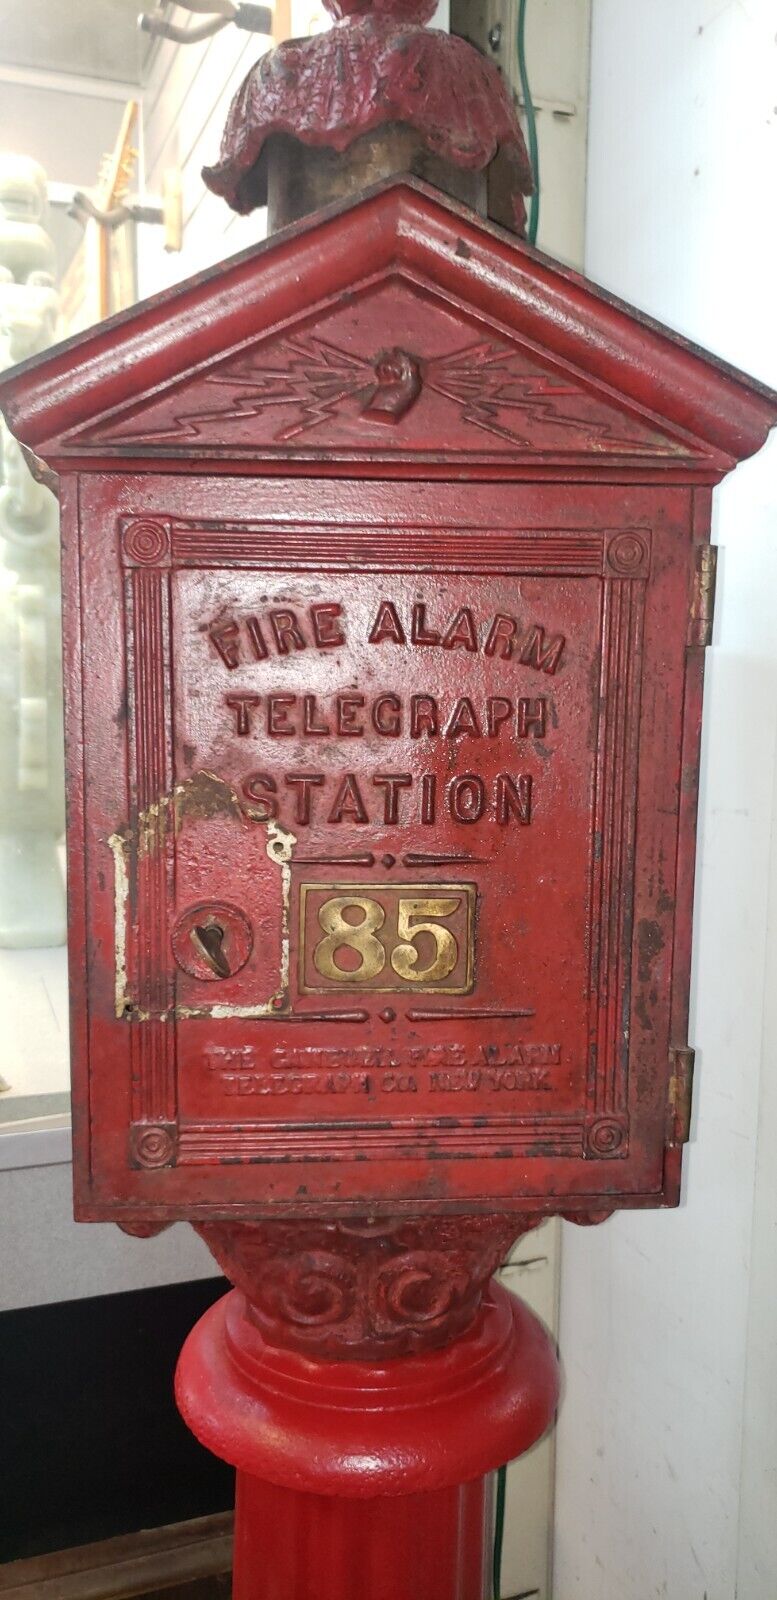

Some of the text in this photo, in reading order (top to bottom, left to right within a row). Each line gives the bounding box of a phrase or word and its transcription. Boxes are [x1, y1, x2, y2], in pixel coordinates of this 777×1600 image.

[207, 600, 566, 676] FIRE ALARM
[225, 693, 548, 740] TELEGRAPH
[242, 772, 536, 827] STATION
[313, 896, 462, 982] 85
[205, 1045, 255, 1070] THE
[428, 1068, 482, 1093] NEW
